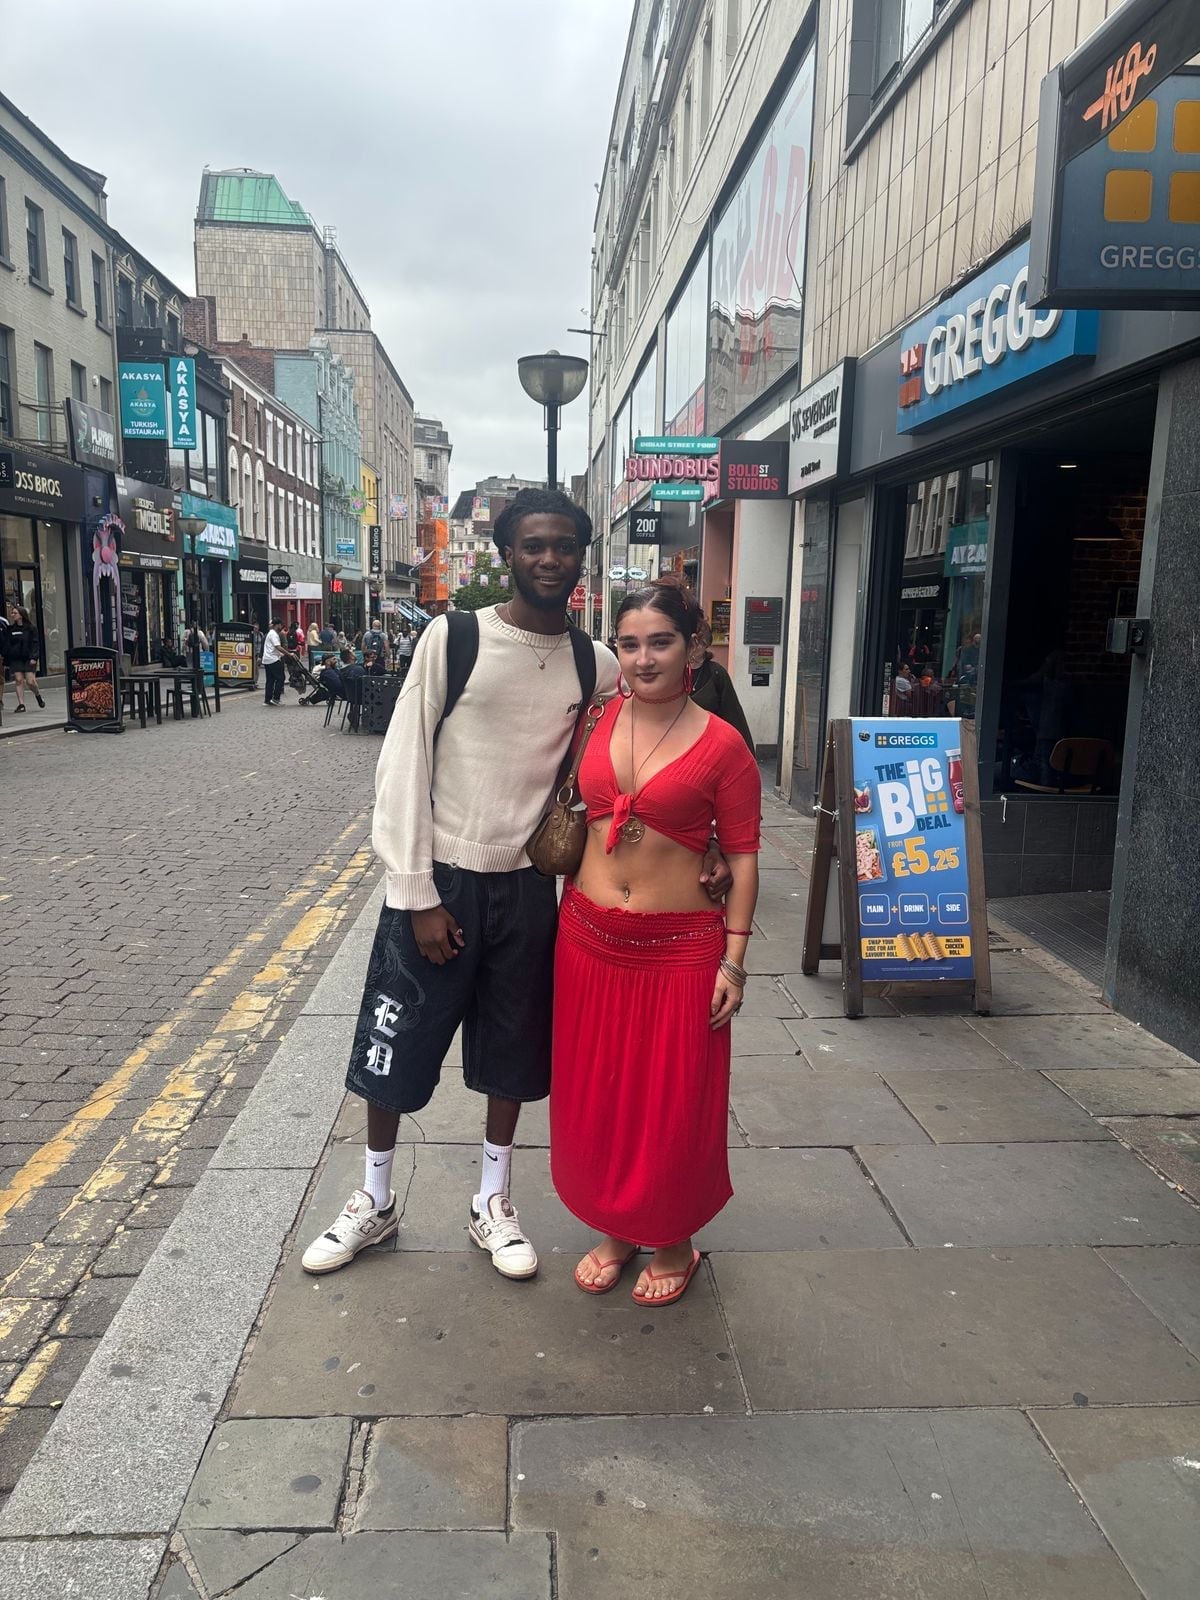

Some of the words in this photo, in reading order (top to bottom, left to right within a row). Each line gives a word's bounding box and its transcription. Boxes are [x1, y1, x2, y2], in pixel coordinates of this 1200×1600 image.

[1100, 245, 1200, 270] GREGG
[121, 372, 162, 381] AKASYA
[176, 360, 190, 435] AKASYA
[801, 385, 839, 432] SEVENSTAY
[124, 428, 165, 436] RESTAURANT
[626, 458, 719, 482] BUNDOBUS
[728, 463, 759, 477] BOLD
[758, 464, 770, 474] ST
[15, 470, 34, 491] OSS
[34, 475, 63, 497] BROS.
[727, 477, 779, 491] STUDIOS
[74, 661, 105, 673] TERIYAKI
[76, 669, 106, 679] NOODLES
[889, 735, 935, 745] GREGGS
[874, 762, 907, 782] THE
[916, 814, 952, 832] DEAL
[888, 840, 903, 849] FROM
[866, 905, 884, 913] MAIN
[903, 904, 924, 913] DRINK
[945, 903, 961, 912] SIDE
